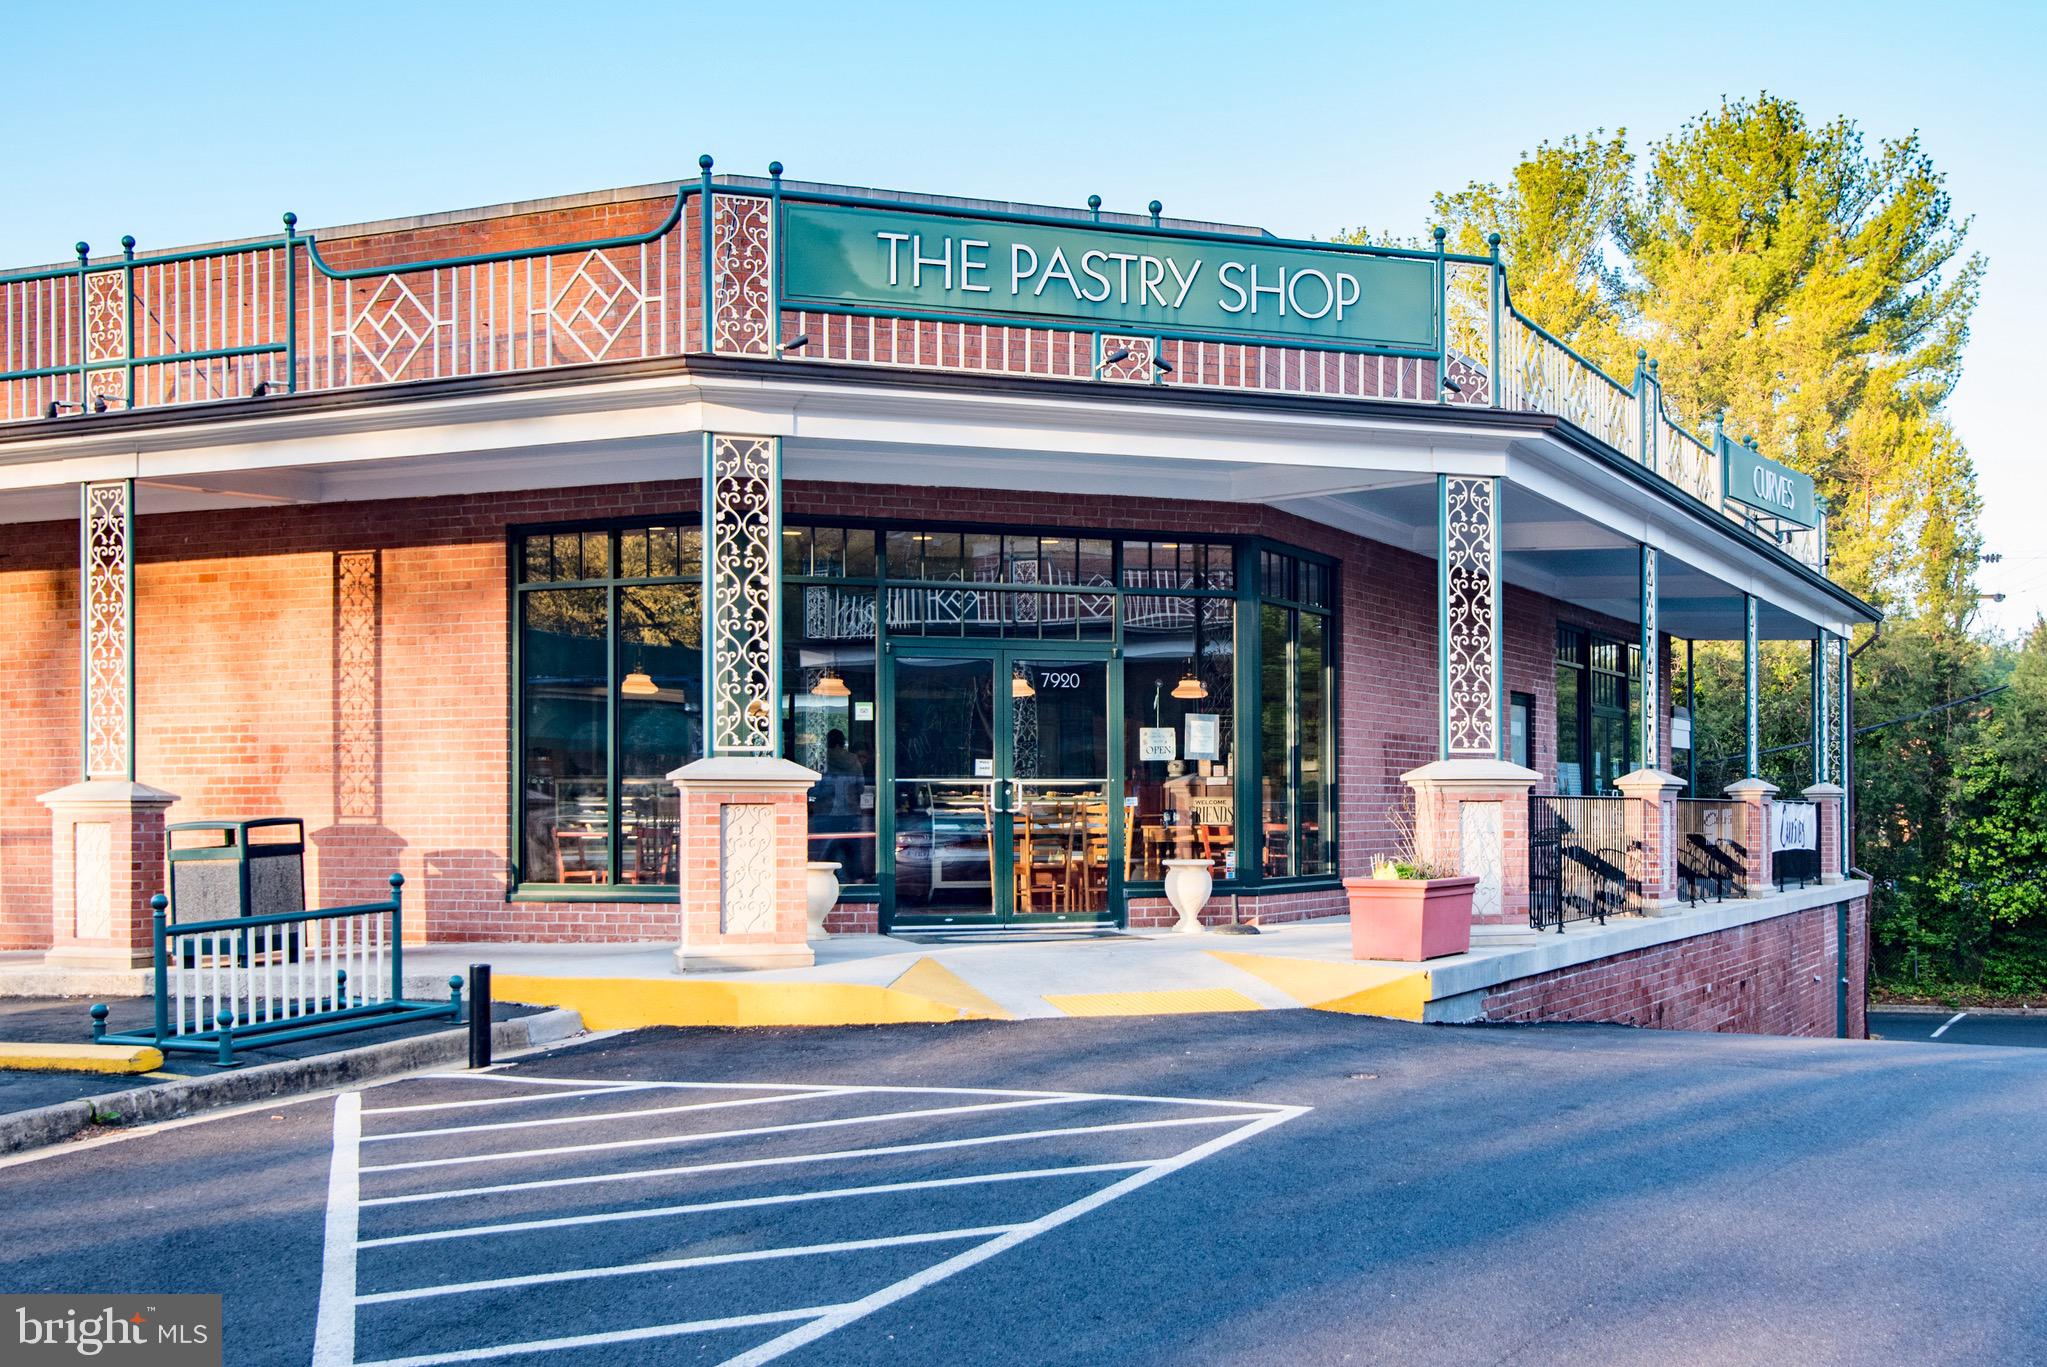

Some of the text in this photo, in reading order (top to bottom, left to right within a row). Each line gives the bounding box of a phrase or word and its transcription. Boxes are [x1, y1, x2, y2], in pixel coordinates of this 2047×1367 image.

[877, 232, 1361, 321] THE PASTRY SHOP
[1753, 465, 1795, 510] CURVES
[1041, 672, 1080, 688] 7920
[1145, 745, 1172, 755] OPEN
